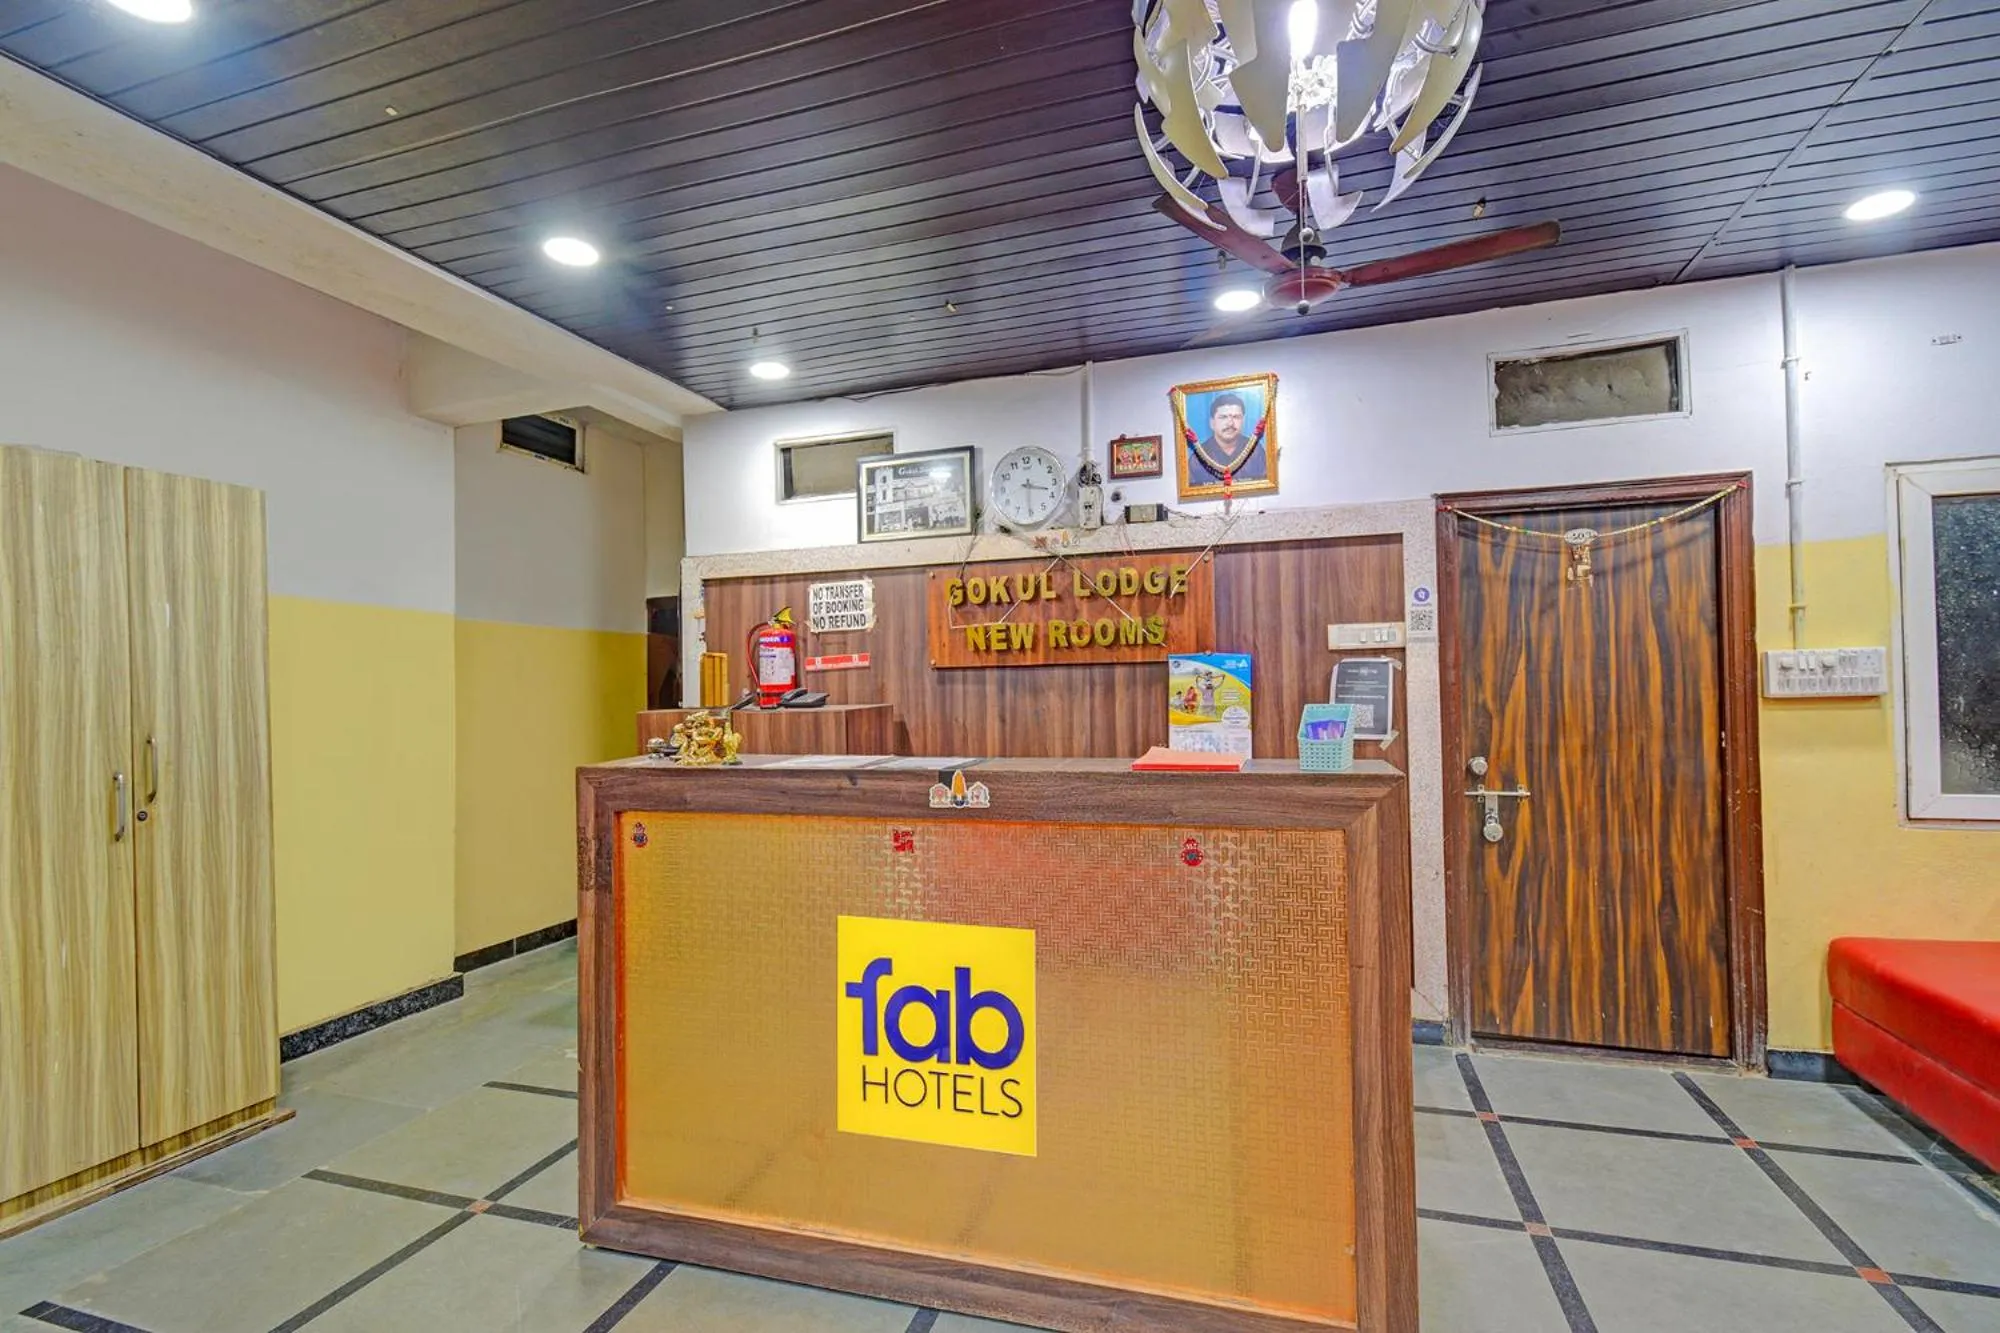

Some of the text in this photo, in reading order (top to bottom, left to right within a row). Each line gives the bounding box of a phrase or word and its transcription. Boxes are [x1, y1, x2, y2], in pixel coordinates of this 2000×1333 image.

[1022, 456, 1030, 464] 12
[1010, 462, 1019, 470] 11
[1046, 466, 1053, 474] 2
[1001, 473, 1011, 481] 10
[1051, 478, 1057, 486] 3
[1049, 491, 1055, 499] 4
[1041, 503, 1046, 511] 5
[944, 565, 1189, 606] GOKUL LODGE
[813, 584, 864, 600] NO TRANSFER
[813, 599, 864, 615] OF BOOKING
[812, 614, 866, 629] NO REFUND
[965, 616, 1166, 651] NEW ROOMS
[845, 957, 1025, 1070] fab
[862, 1065, 1023, 1118] HOTELS
